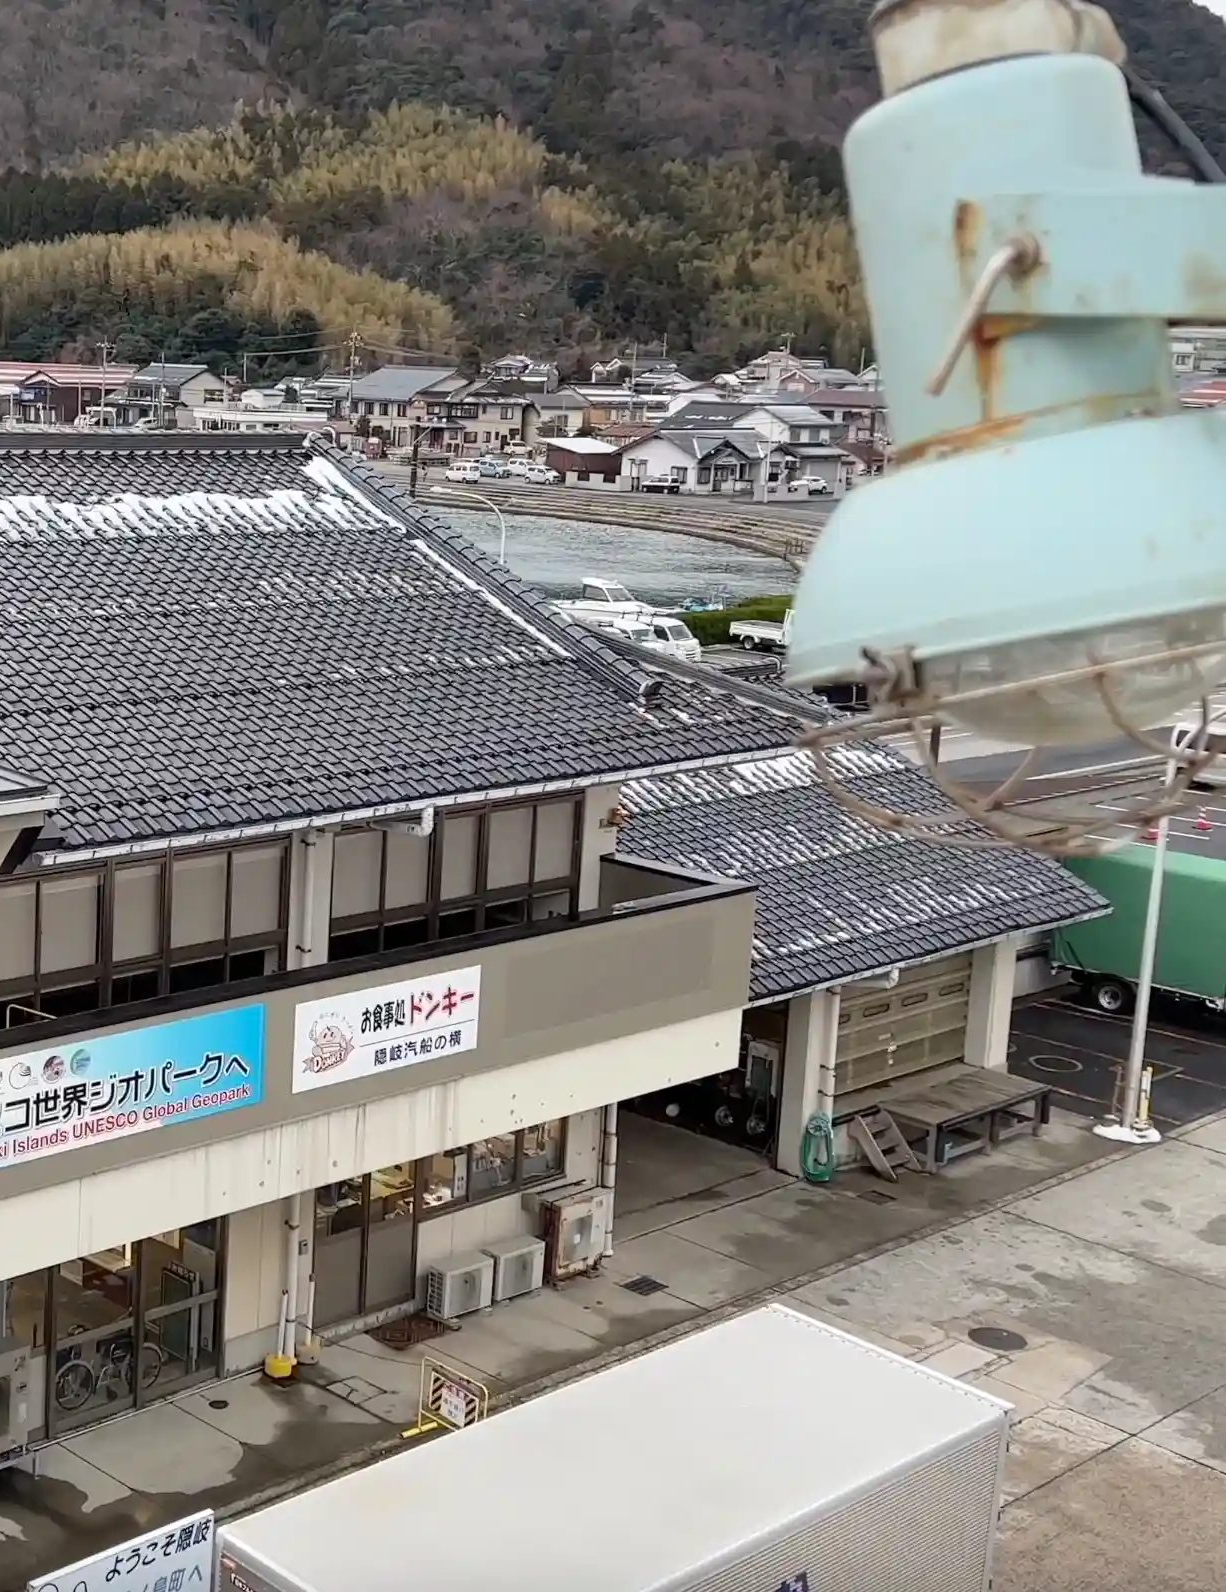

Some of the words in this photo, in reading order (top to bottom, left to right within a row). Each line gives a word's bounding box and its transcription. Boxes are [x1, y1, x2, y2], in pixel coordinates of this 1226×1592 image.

[360, 984, 474, 1034] お食事処ドンキー
[374, 1029, 462, 1067] 隠岐汽船の横
[13, 1129, 68, 1154] Islands
[73, 1110, 138, 1139] UNESCO
[142, 1098, 188, 1122] Global
[192, 1084, 250, 1109] Geopark
[105, 1519, 212, 1582] ようこそ隠岐
